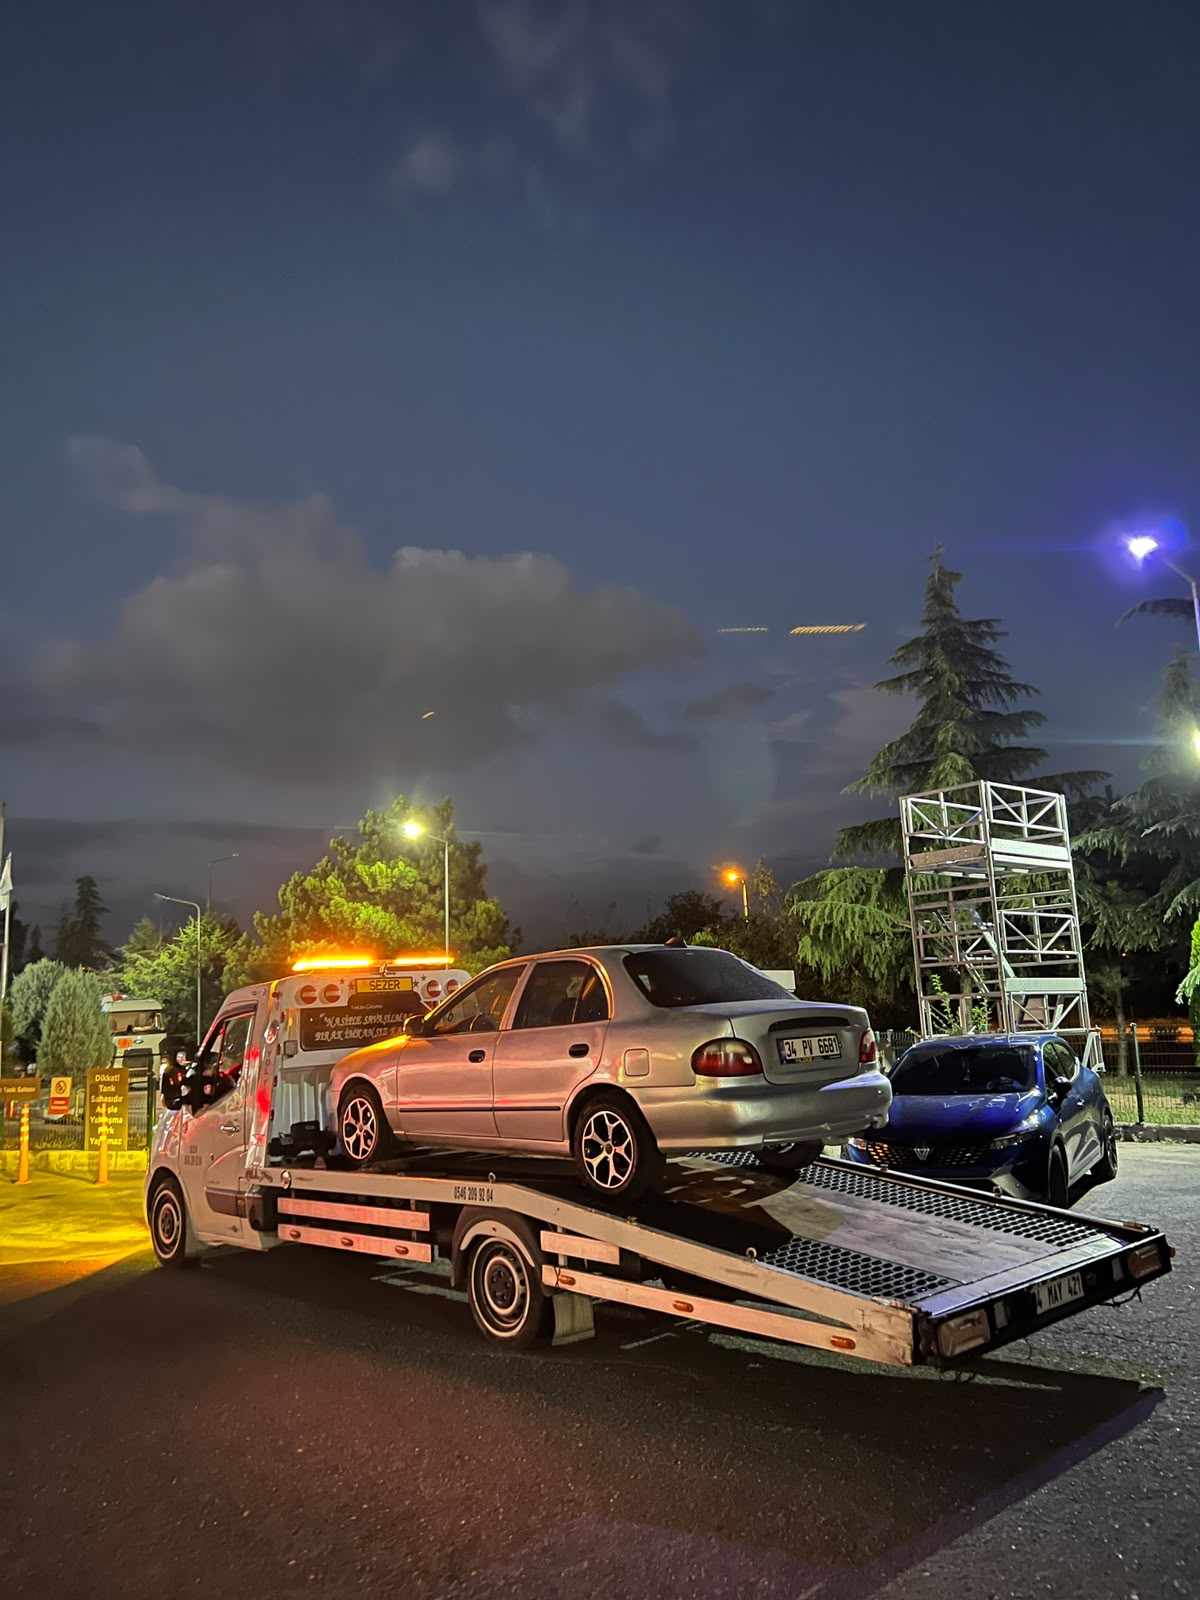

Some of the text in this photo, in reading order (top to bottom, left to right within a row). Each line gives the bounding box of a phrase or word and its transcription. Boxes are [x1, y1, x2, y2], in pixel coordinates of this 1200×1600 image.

[369, 979, 400, 991] SEZER
[785, 1037, 838, 1057] 34 PV 6681
[95, 1074, 120, 1082] Dikkat!
[99, 1084, 116, 1093] Tank
[98, 1126, 115, 1135] Prk
[1047, 1281, 1063, 1306] MAY
[1068, 1275, 1082, 1297] 421
